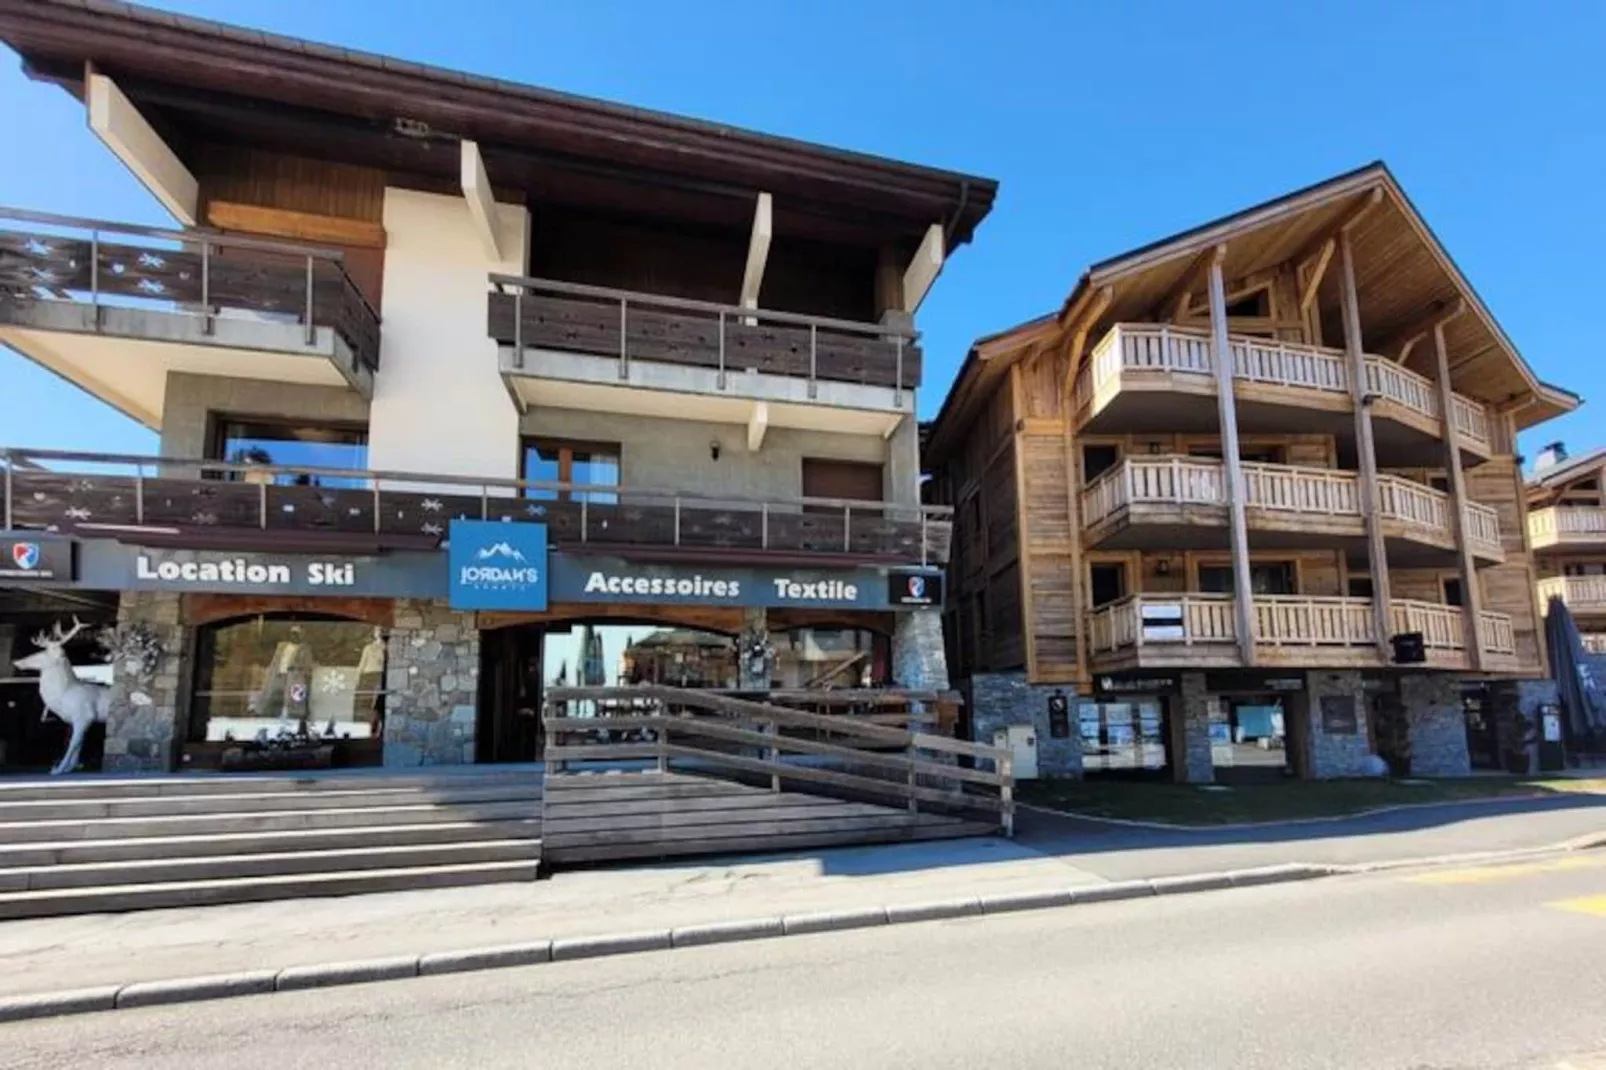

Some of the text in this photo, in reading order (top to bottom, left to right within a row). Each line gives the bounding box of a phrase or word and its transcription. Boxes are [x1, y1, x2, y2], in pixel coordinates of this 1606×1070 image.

[137, 556, 355, 585] Location Ski
[460, 566, 539, 584] JORDAN'S
[584, 572, 858, 600] Accessoires Textile
